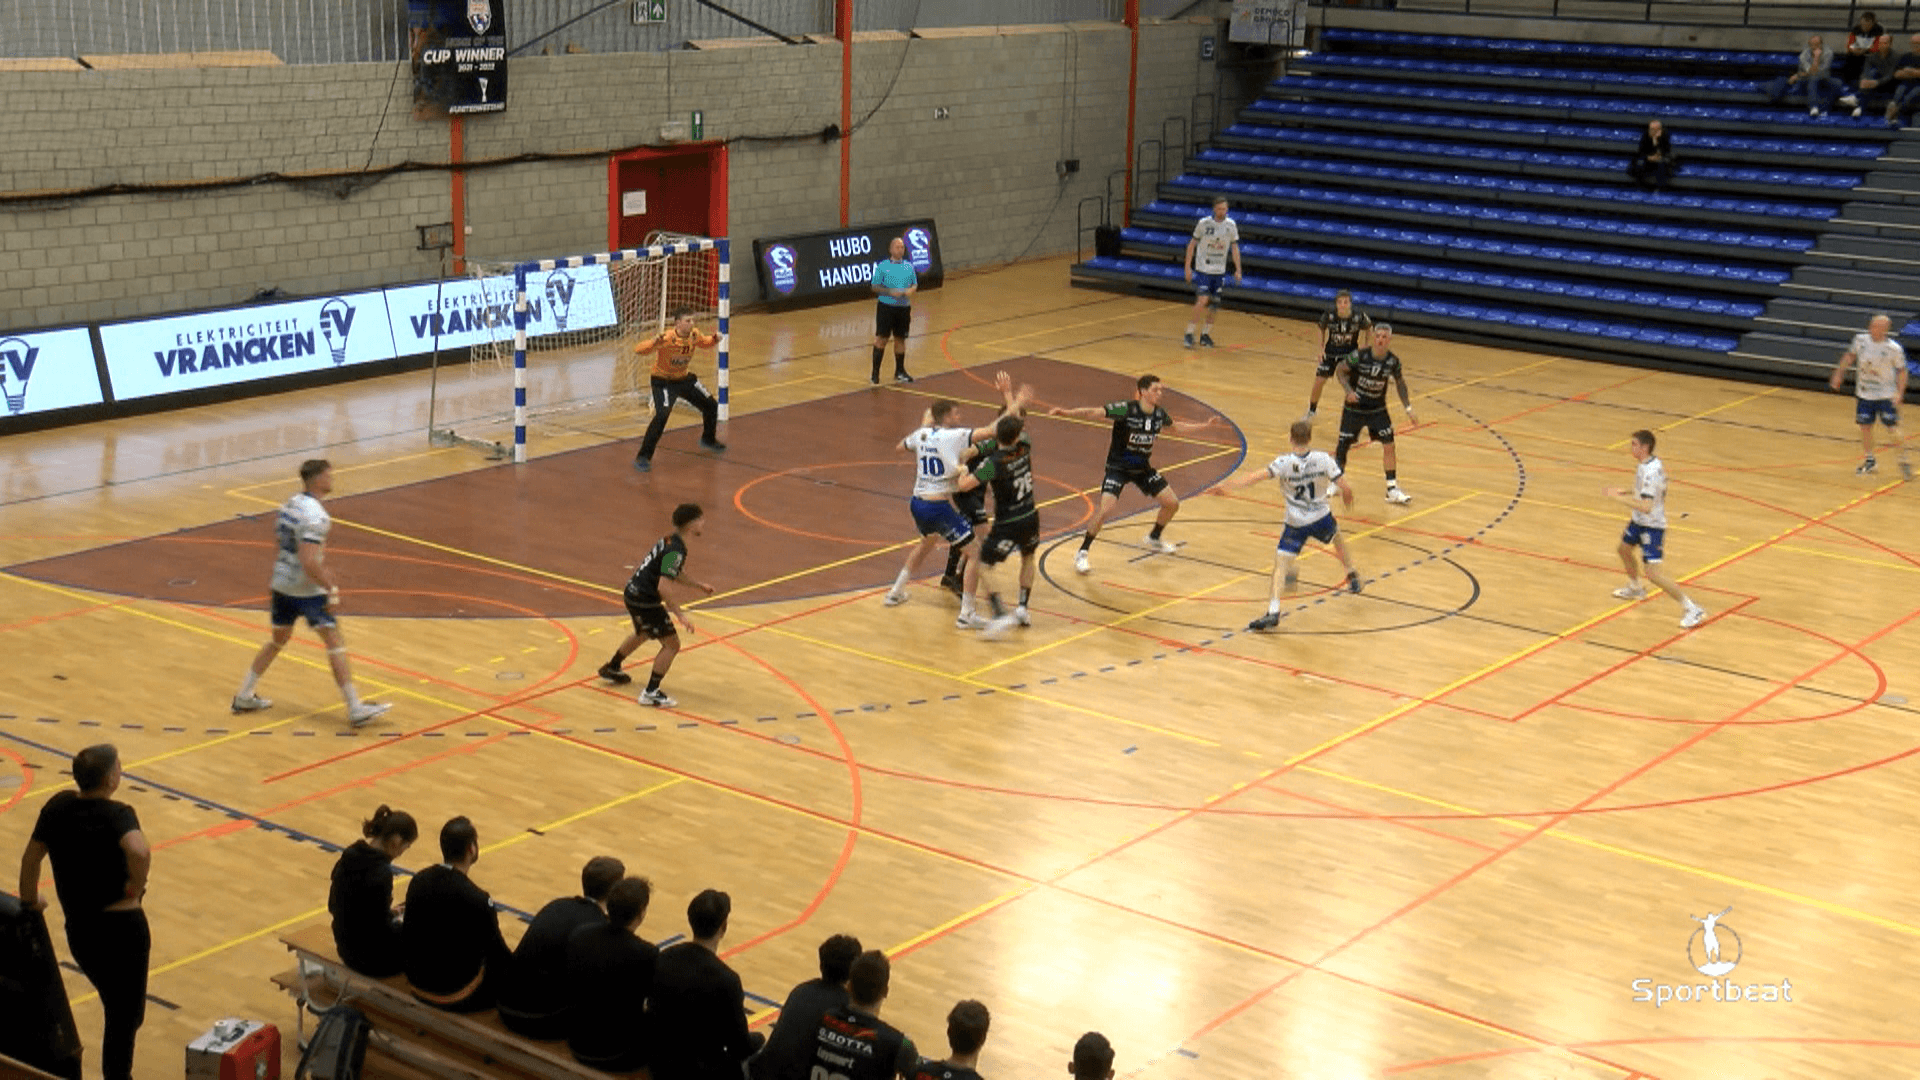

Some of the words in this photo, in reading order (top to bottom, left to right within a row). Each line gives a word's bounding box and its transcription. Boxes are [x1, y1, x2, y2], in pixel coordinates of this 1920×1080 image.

[423, 49, 451, 65] CUP
[455, 47, 505, 63] WINNER
[829, 235, 872, 259] HUBO
[410, 297, 542, 339] VRANCKN
[176, 317, 298, 347] ELEKTRICITEIT
[154, 326, 316, 378] VRANCKEN
[920, 455, 945, 477] 10
[1294, 481, 1315, 500] 21
